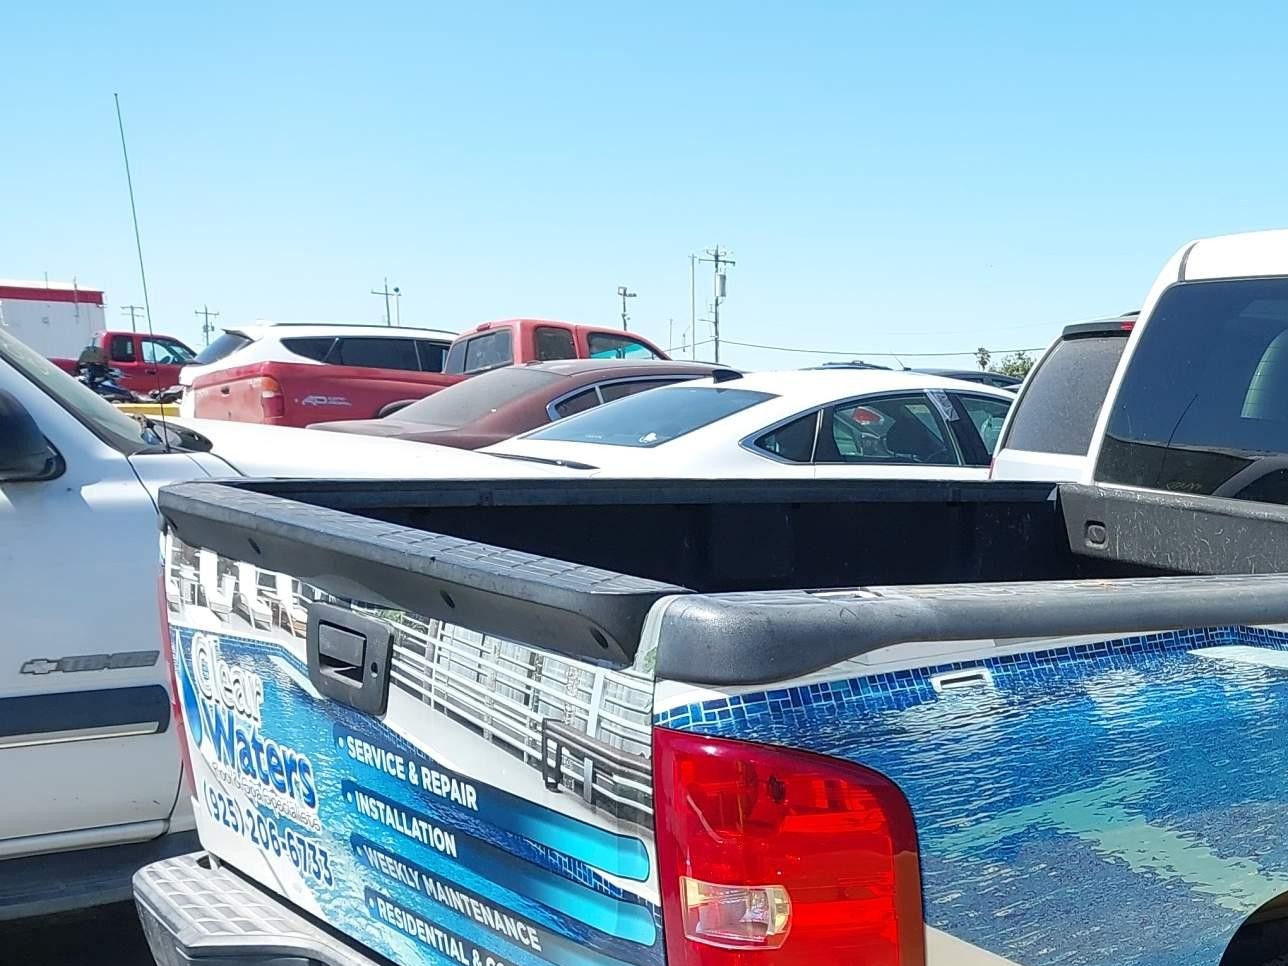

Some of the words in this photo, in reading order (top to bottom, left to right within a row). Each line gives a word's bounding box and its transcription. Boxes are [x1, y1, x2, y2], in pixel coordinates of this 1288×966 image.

[191, 632, 264, 723] Clear
[201, 701, 318, 809] Waters
[347, 735, 406, 782] SERVICE
[408, 763, 419, 785] &
[421, 766, 479, 812] REPAIR
[203, 780, 246, 837] (925)
[245, 808, 334, 887] 206-6733
[355, 791, 458, 858] INSTALLATION
[363, 844, 421, 890] WEEKLY
[422, 874, 543, 952] MAINTENANCE
